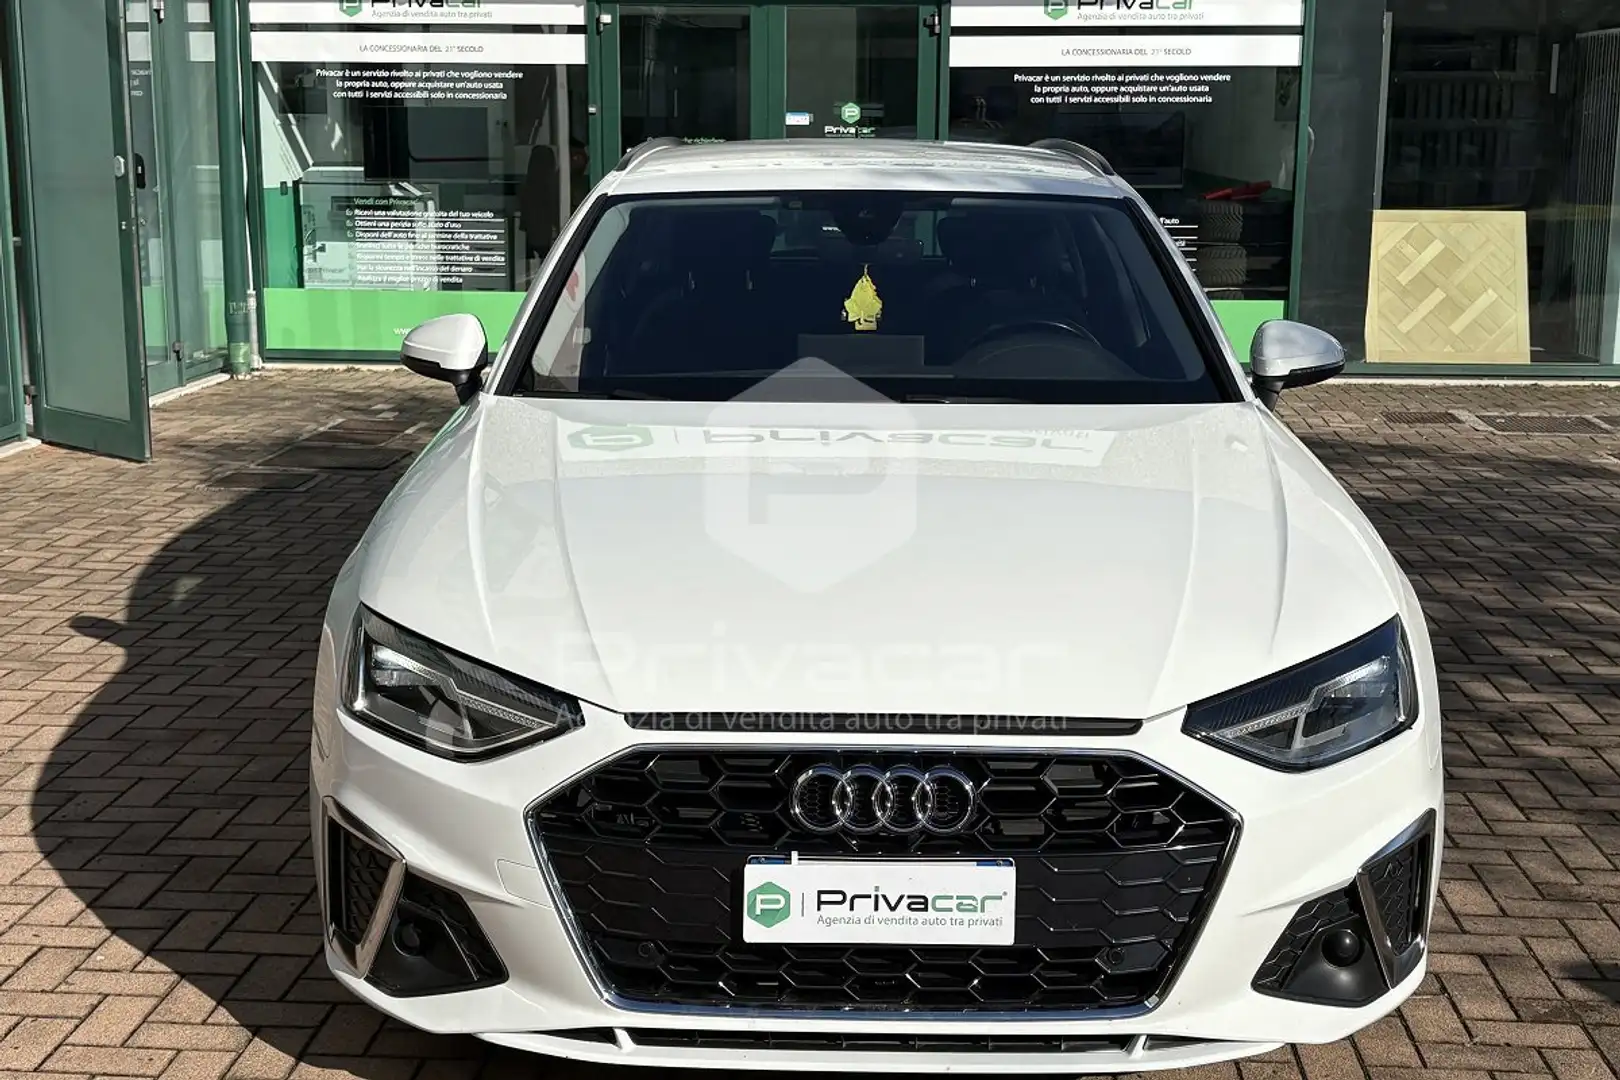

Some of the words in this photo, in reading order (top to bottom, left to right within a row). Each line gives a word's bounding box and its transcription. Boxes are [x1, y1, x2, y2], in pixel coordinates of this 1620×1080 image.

[316, 69, 344, 77] Privacar
[362, 69, 389, 77] servizio
[391, 69, 414, 77] rivolto
[415, 69, 421, 77] ai
[423, 69, 445, 79] privati
[446, 69, 460, 77] che
[461, 70, 492, 80] vogliono
[493, 71, 523, 79] vendere
[1014, 74, 1043, 82] Privacar
[1062, 74, 1090, 82] servizio
[1092, 74, 1116, 82] rivolto
[1117, 74, 1124, 82] ai
[1125, 74, 1149, 83] privati
[1150, 74, 1165, 82] che
[1166, 74, 1199, 84] vogliono
[1200, 74, 1231, 82] vendere
[1043, 85, 1070, 94] propria
[1091, 86, 1118, 94] oppure
[1119, 85, 1158, 94] acquistare
[370, 91, 392, 99] servizi
[393, 91, 429, 99] accessibili
[430, 91, 444, 99] solo
[446, 91, 454, 99] in
[455, 91, 507, 100] concessionaria
[817, 916, 861, 927] Agenzia
[864, 916, 875, 925] di
[878, 916, 919, 925] vendita
[921, 917, 946, 926] auto
[950, 917, 965, 926] tra
[968, 917, 1002, 928] privati
